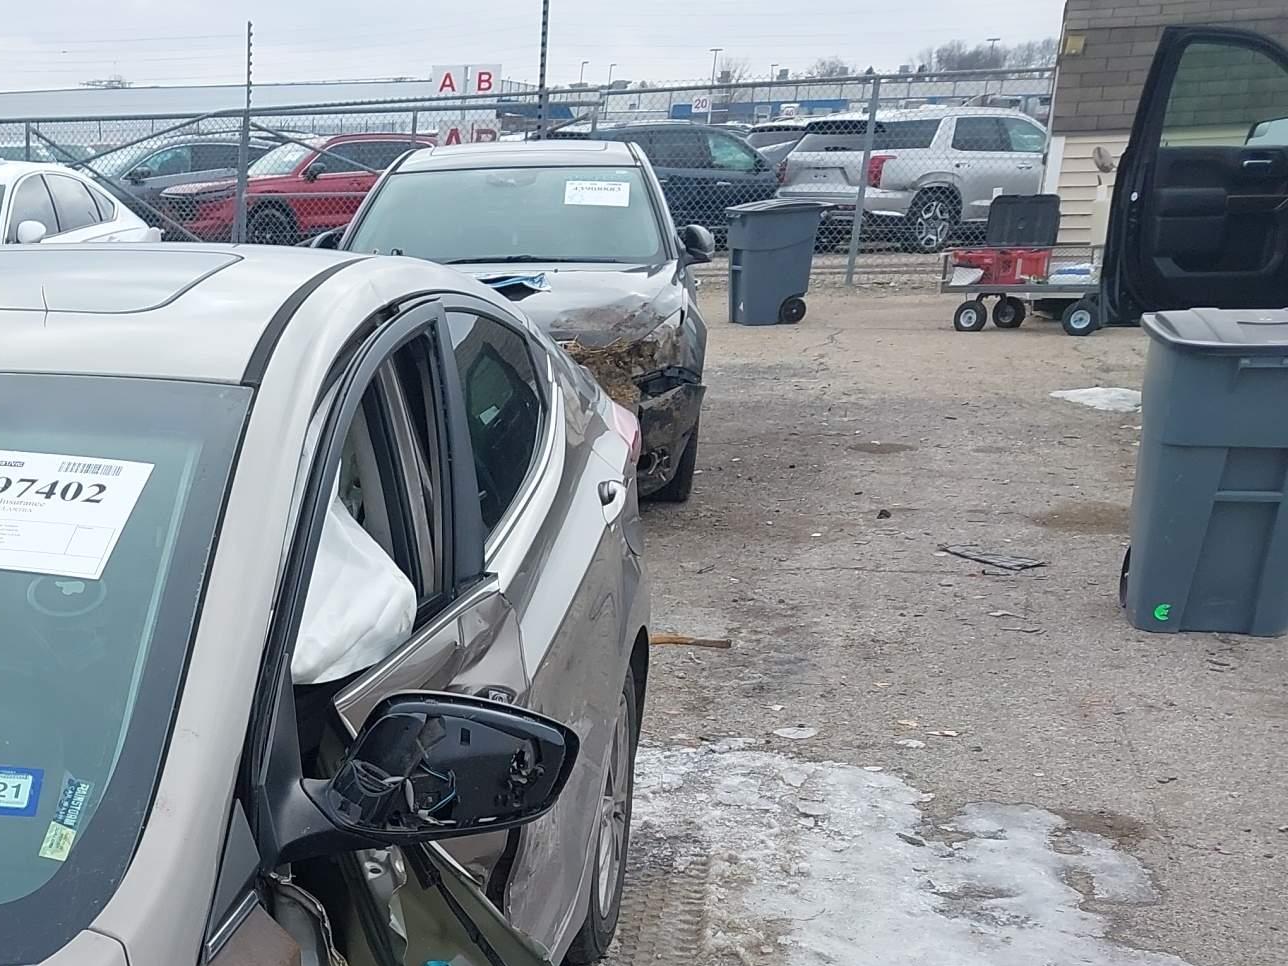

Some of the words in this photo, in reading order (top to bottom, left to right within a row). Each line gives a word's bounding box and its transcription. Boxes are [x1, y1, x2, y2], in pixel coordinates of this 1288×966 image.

[439, 72, 456, 92] A
[477, 71, 492, 91] B
[694, 99, 708, 109] 20
[0, 497, 47, 508] Insurance
